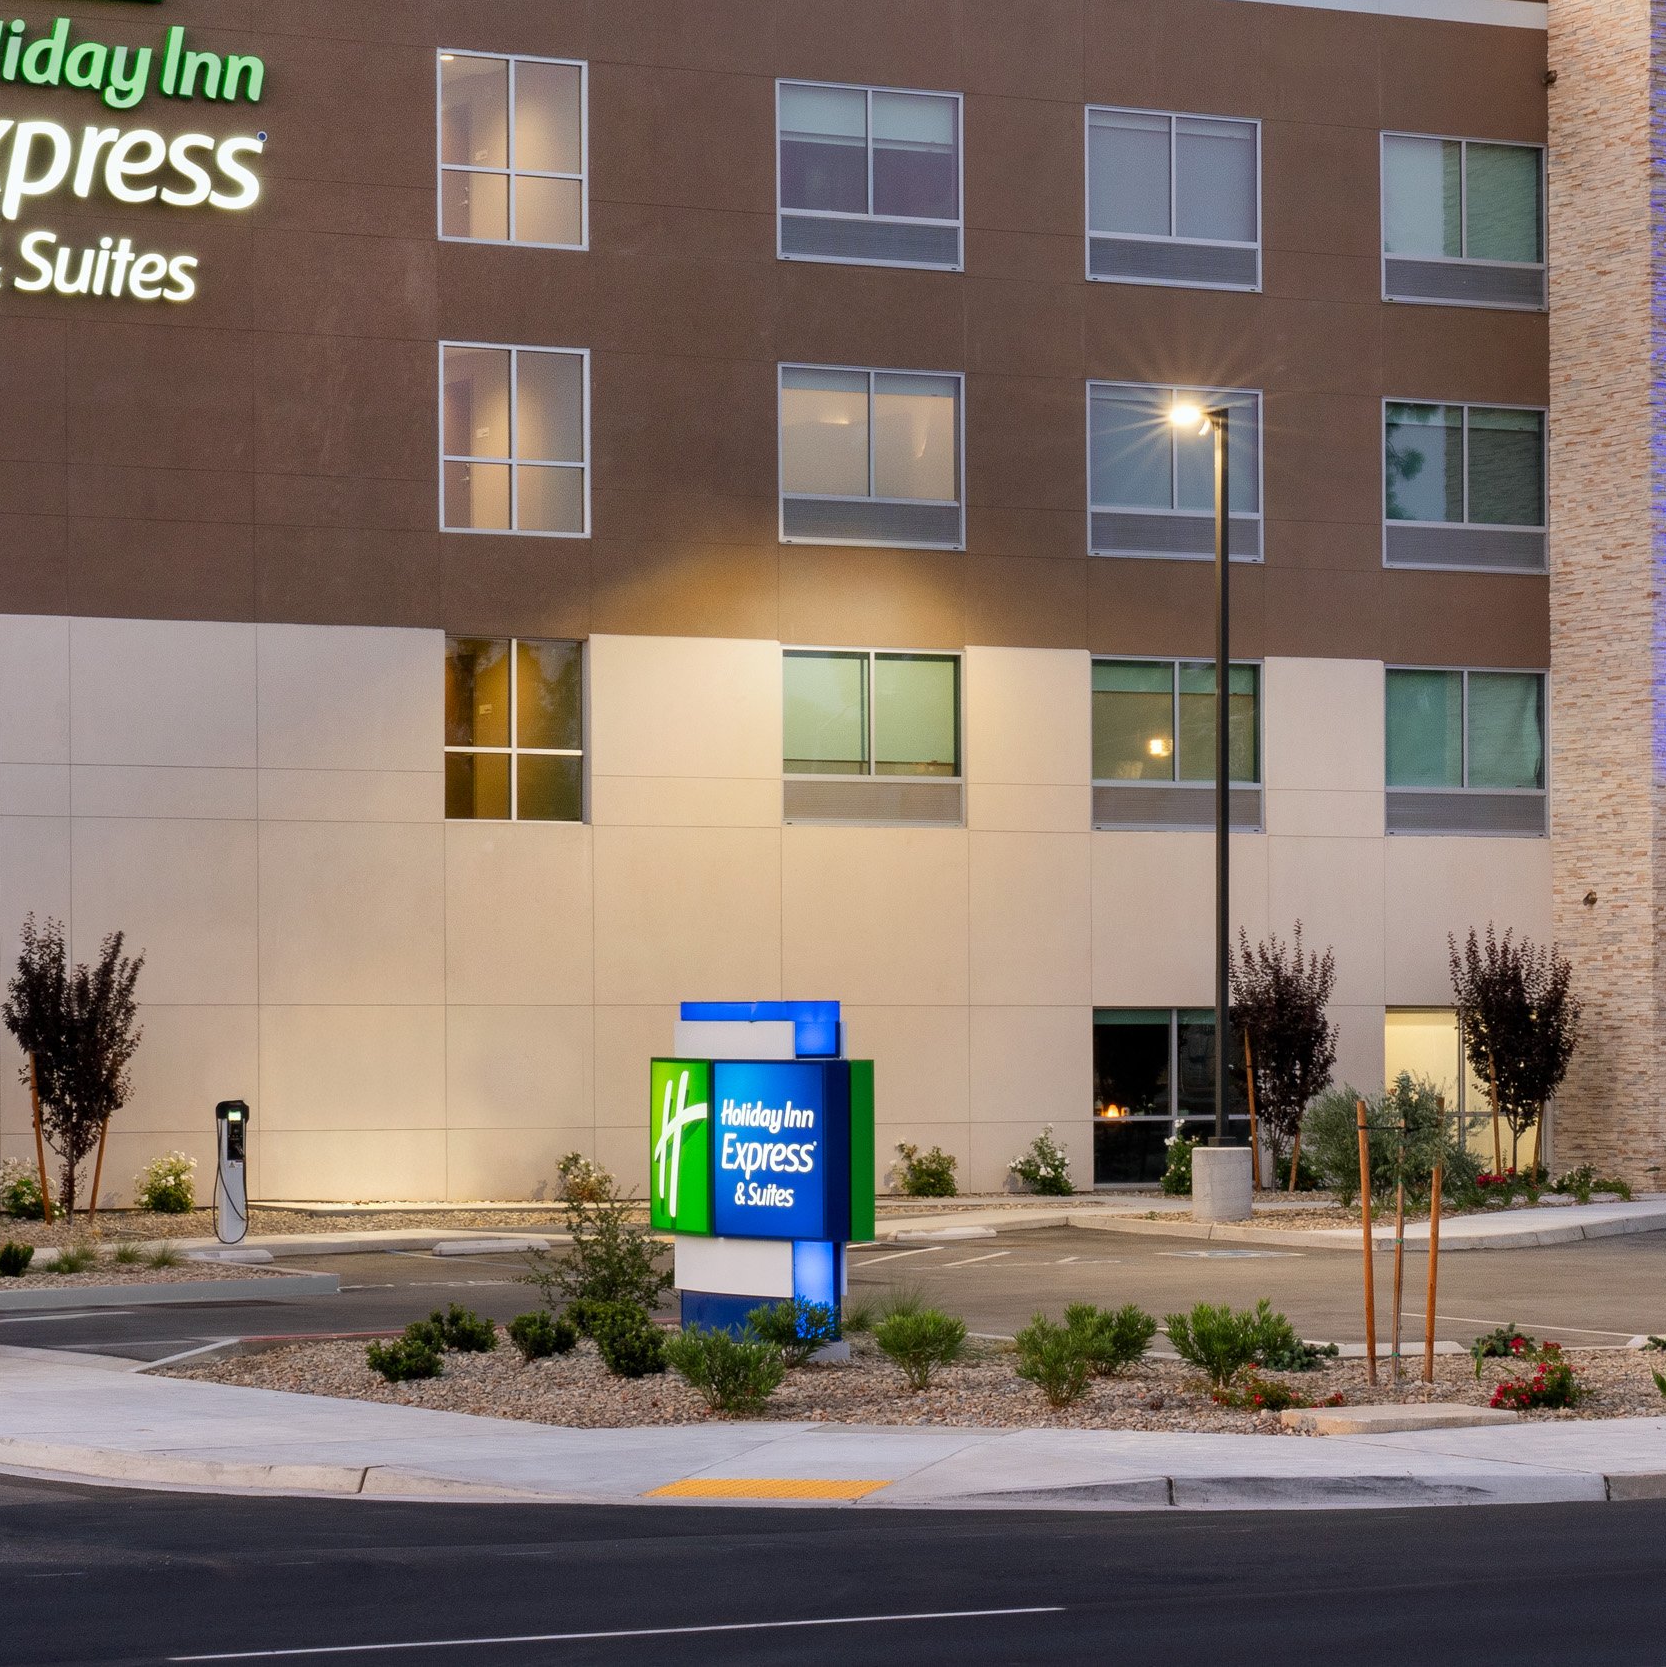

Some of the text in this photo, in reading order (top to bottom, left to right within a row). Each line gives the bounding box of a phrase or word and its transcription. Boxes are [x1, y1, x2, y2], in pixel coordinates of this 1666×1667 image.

[158, 26, 265, 102] Inn
[14, 230, 199, 301] Suites
[720, 1098, 815, 1134] Holiday Inn
[721, 1132, 814, 1180] Express
[734, 1181, 794, 1207] & Suites
